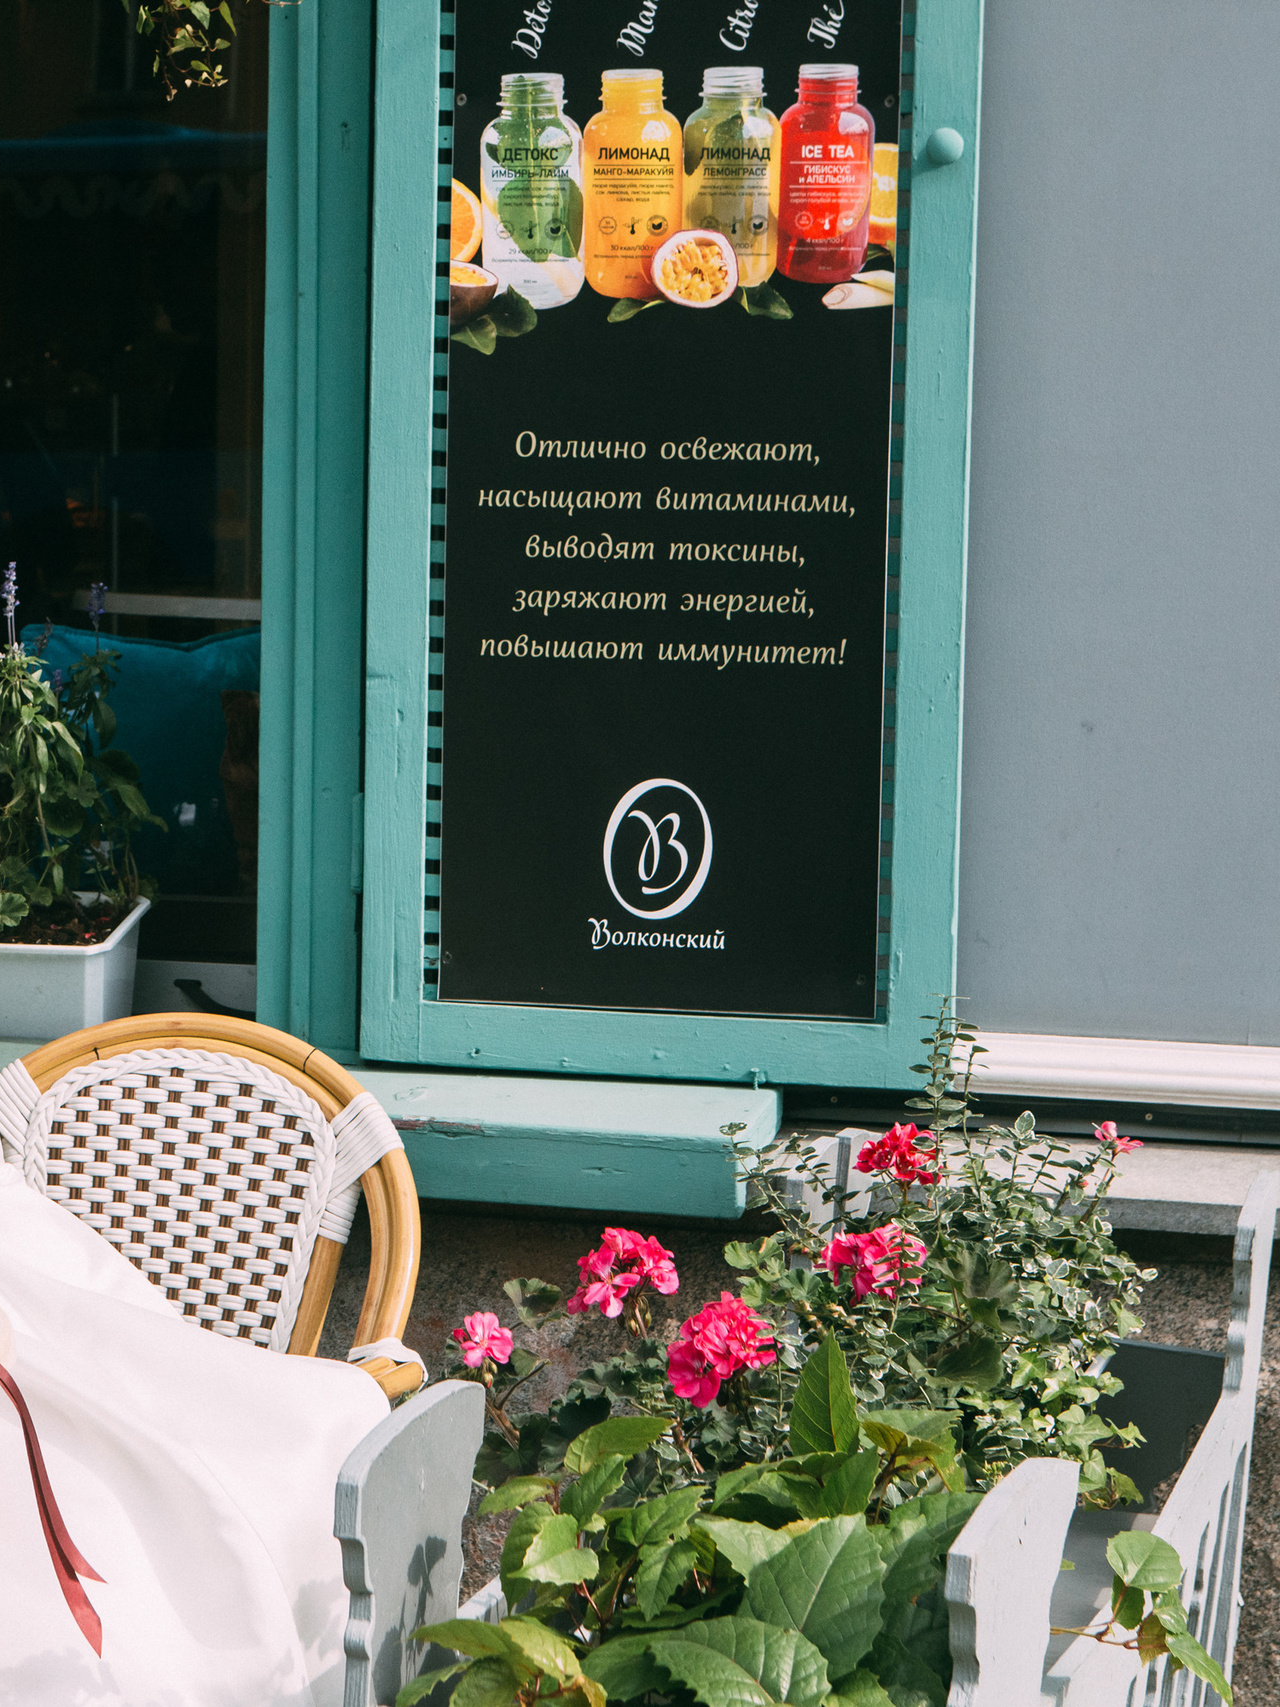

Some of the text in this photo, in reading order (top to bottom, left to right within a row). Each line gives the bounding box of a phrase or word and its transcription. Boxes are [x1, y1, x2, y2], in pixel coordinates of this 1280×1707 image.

[511, 0, 552, 59] Déto
[502, 147, 559, 163] ДЕТОКС
[597, 147, 670, 162] ЛИМОНАД
[700, 147, 771, 162] ЛИМОНАД
[801, 145, 855, 158] ICE TEA
[593, 165, 674, 176] МАНГО-МАРАКУЙЯ
[703, 167, 767, 177] ЛЕМОНГРАСС
[804, 165, 851, 174] ГИБИСКУС
[806, 175, 856, 184] АПЕЛЬСИН
[515, 430, 821, 467] Отлично освежают,
[478, 486, 857, 518] насыщают витаминами,
[524, 533, 806, 568] выводят токсины,
[512, 587, 815, 620] заряжают энергией,
[479, 634, 848, 670] повышают иммунитет!
[587, 917, 726, 950] Волконский
